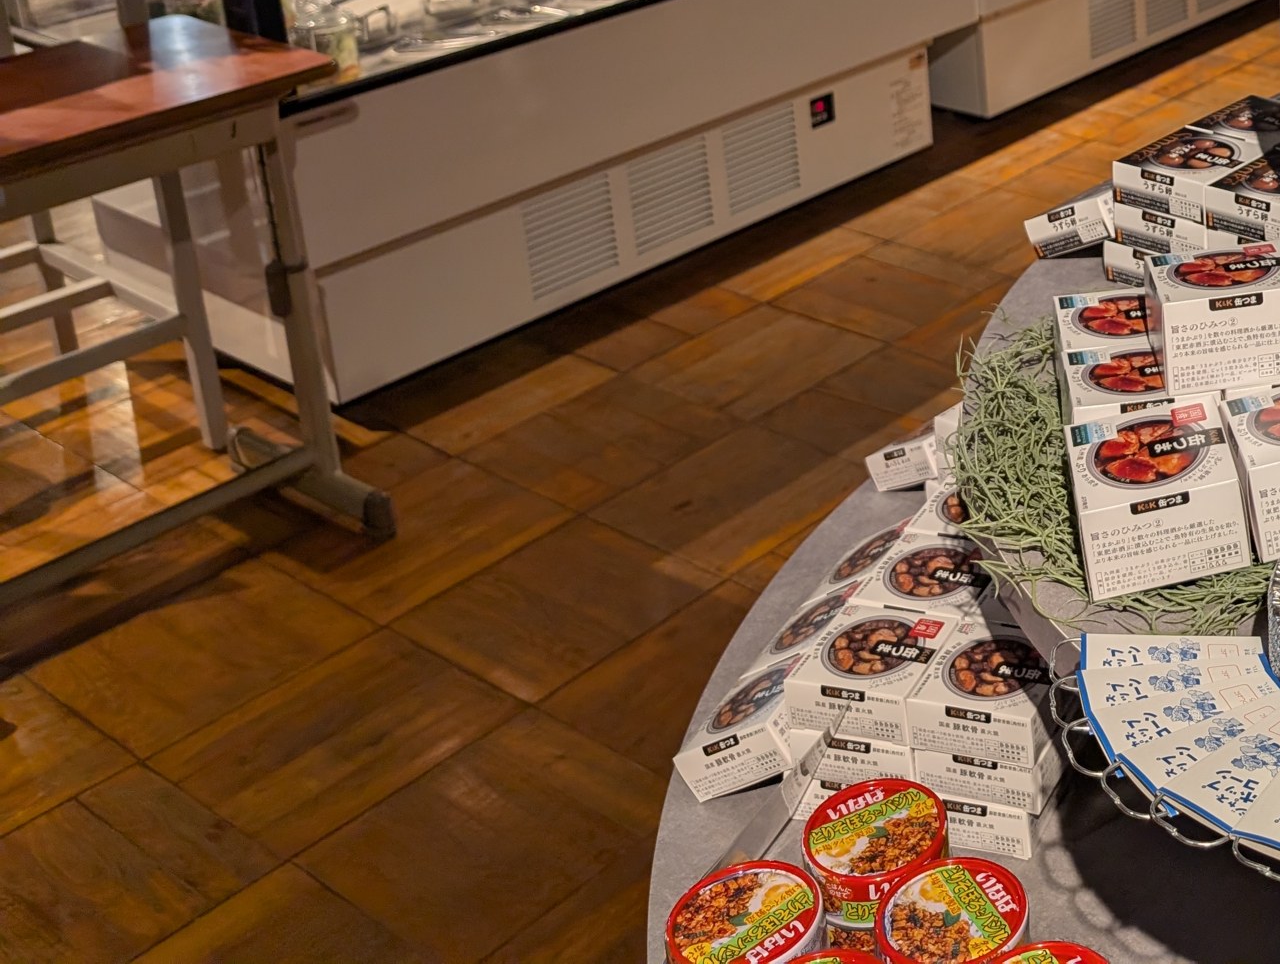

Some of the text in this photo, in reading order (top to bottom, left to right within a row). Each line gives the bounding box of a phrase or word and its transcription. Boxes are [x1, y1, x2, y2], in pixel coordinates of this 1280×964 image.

[1216, 296, 1257, 308] K&K 缶つま
[1138, 495, 1183, 511] K&K 缶つま
[841, 690, 861, 701] 缶つま
[966, 711, 987, 722] 缶つま
[827, 787, 885, 820] いなば
[811, 790, 922, 844] とりそぼろとバジル
[975, 872, 1019, 913] いなば
